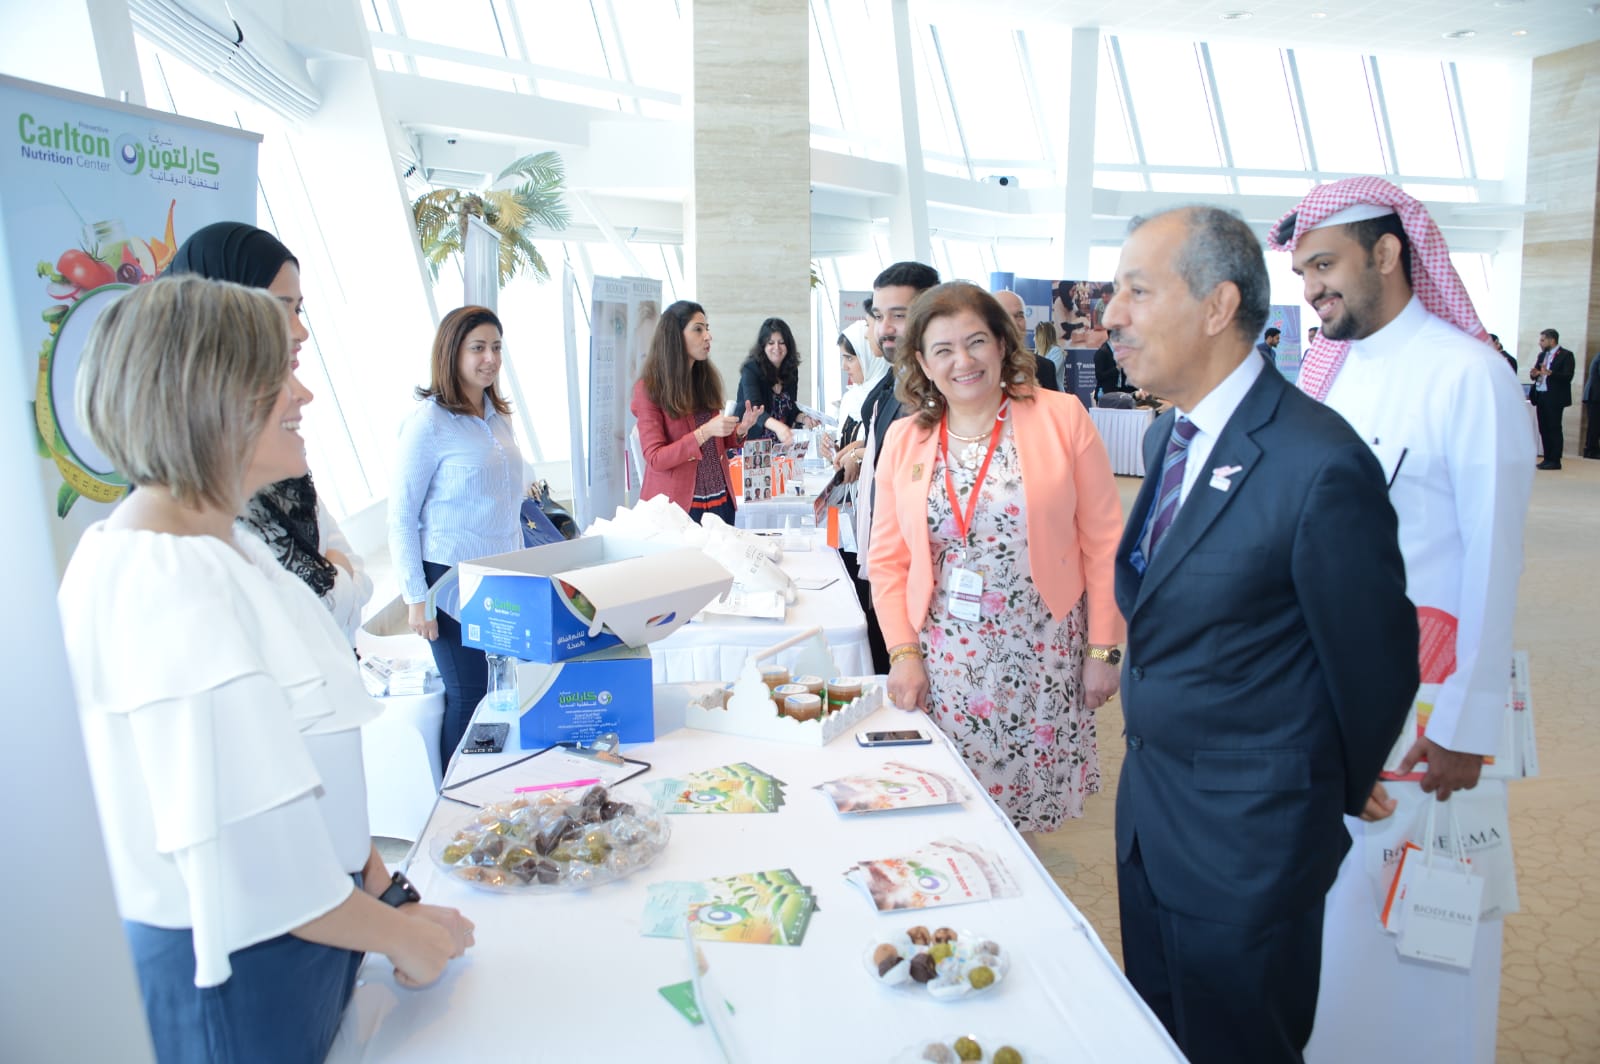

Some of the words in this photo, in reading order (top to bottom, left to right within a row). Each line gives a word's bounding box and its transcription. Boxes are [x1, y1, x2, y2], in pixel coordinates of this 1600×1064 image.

[18, 112, 111, 158] Carlton
[148, 134, 173, 147] شركة
[21, 145, 73, 167] Nutrition
[76, 153, 110, 172] Center
[148, 145, 220, 175] كارلتون
[1383, 827, 1501, 862] BIEMA
[1413, 903, 1473, 922] BIODERMA
